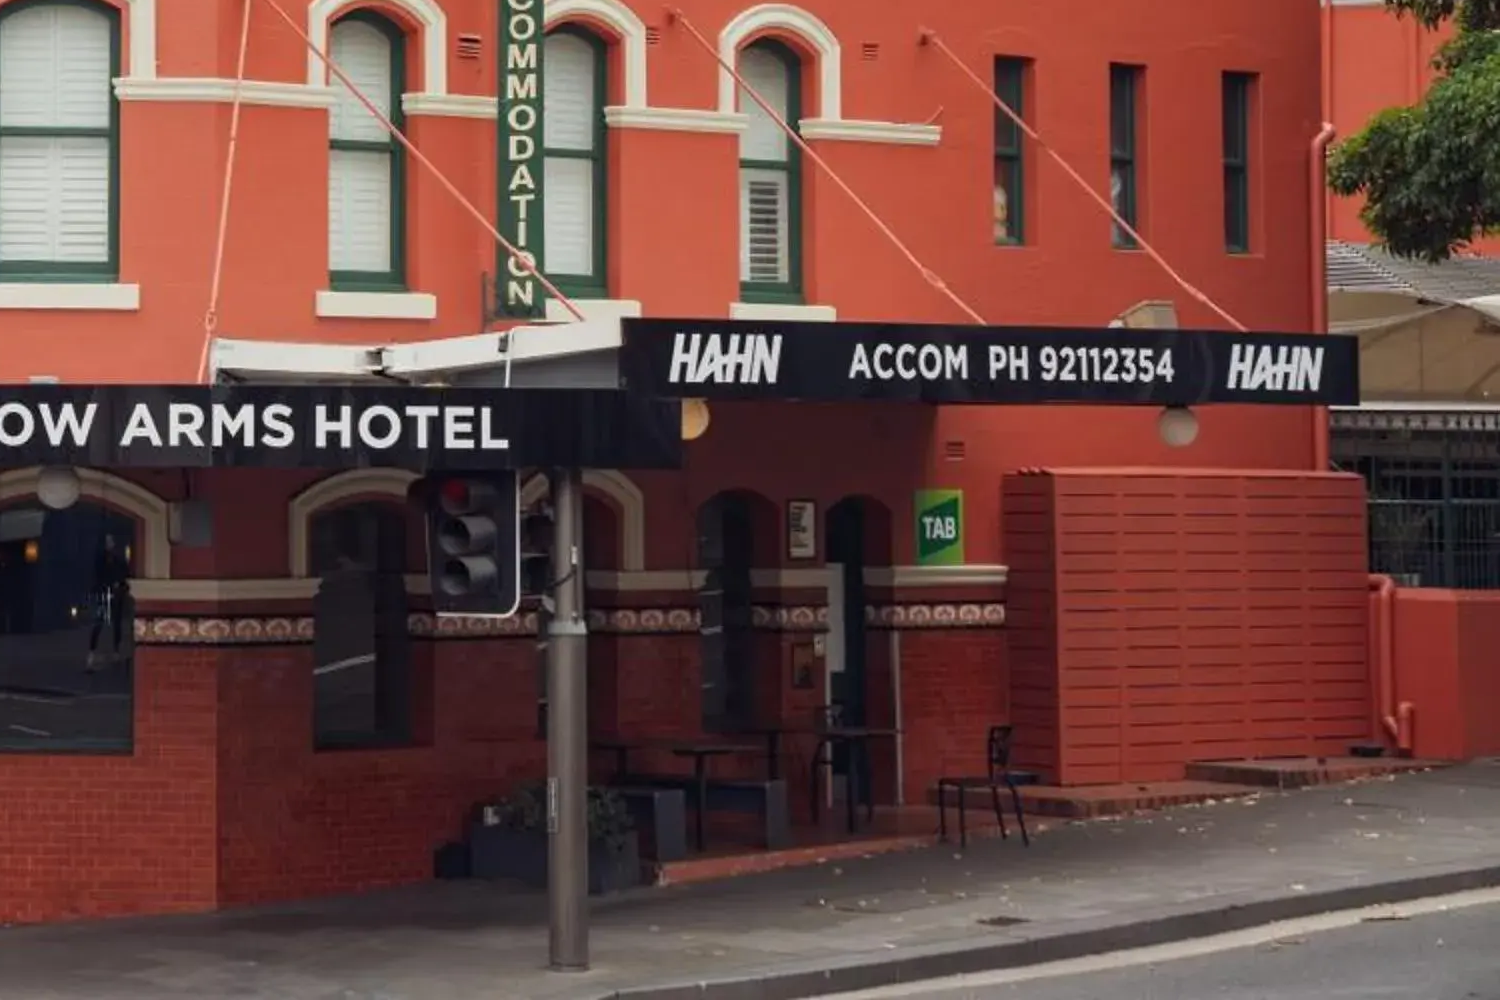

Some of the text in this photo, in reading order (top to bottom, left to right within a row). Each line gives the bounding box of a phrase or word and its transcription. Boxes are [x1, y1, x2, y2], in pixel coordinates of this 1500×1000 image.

[669, 333, 783, 384] HAHN
[848, 343, 1175, 383] ACCOM PH 92112354
[1227, 344, 1324, 391] HAHN
[119, 404, 294, 447] ARMS
[314, 405, 509, 450] HOTEL
[922, 516, 956, 539] TAB
